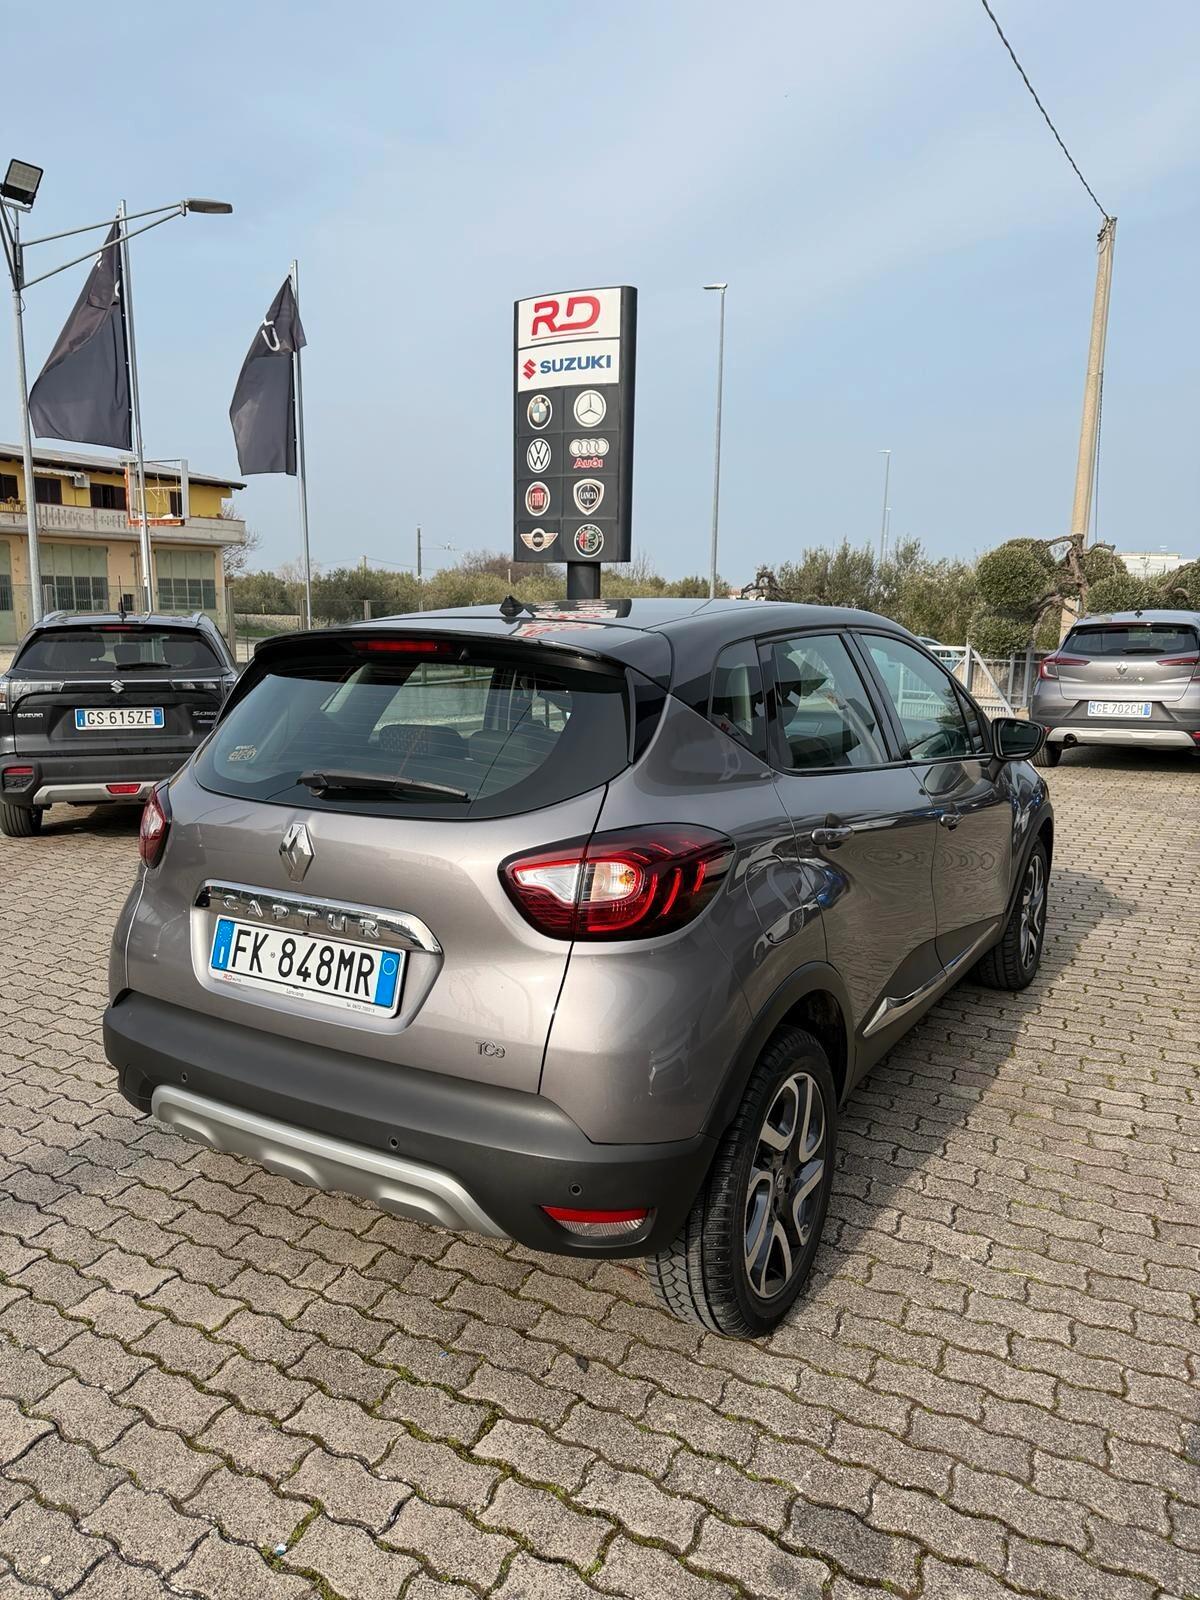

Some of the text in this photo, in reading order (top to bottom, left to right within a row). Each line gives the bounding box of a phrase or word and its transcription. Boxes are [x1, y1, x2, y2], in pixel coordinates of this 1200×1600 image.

[540, 354, 612, 375] SUZUKI
[573, 457, 604, 469] Audi
[87, 711, 105, 725] GS
[109, 710, 152, 725] 615ZF
[223, 894, 381, 939] CAPTUR
[231, 929, 269, 974] FK
[277, 937, 375, 997] 848MR
